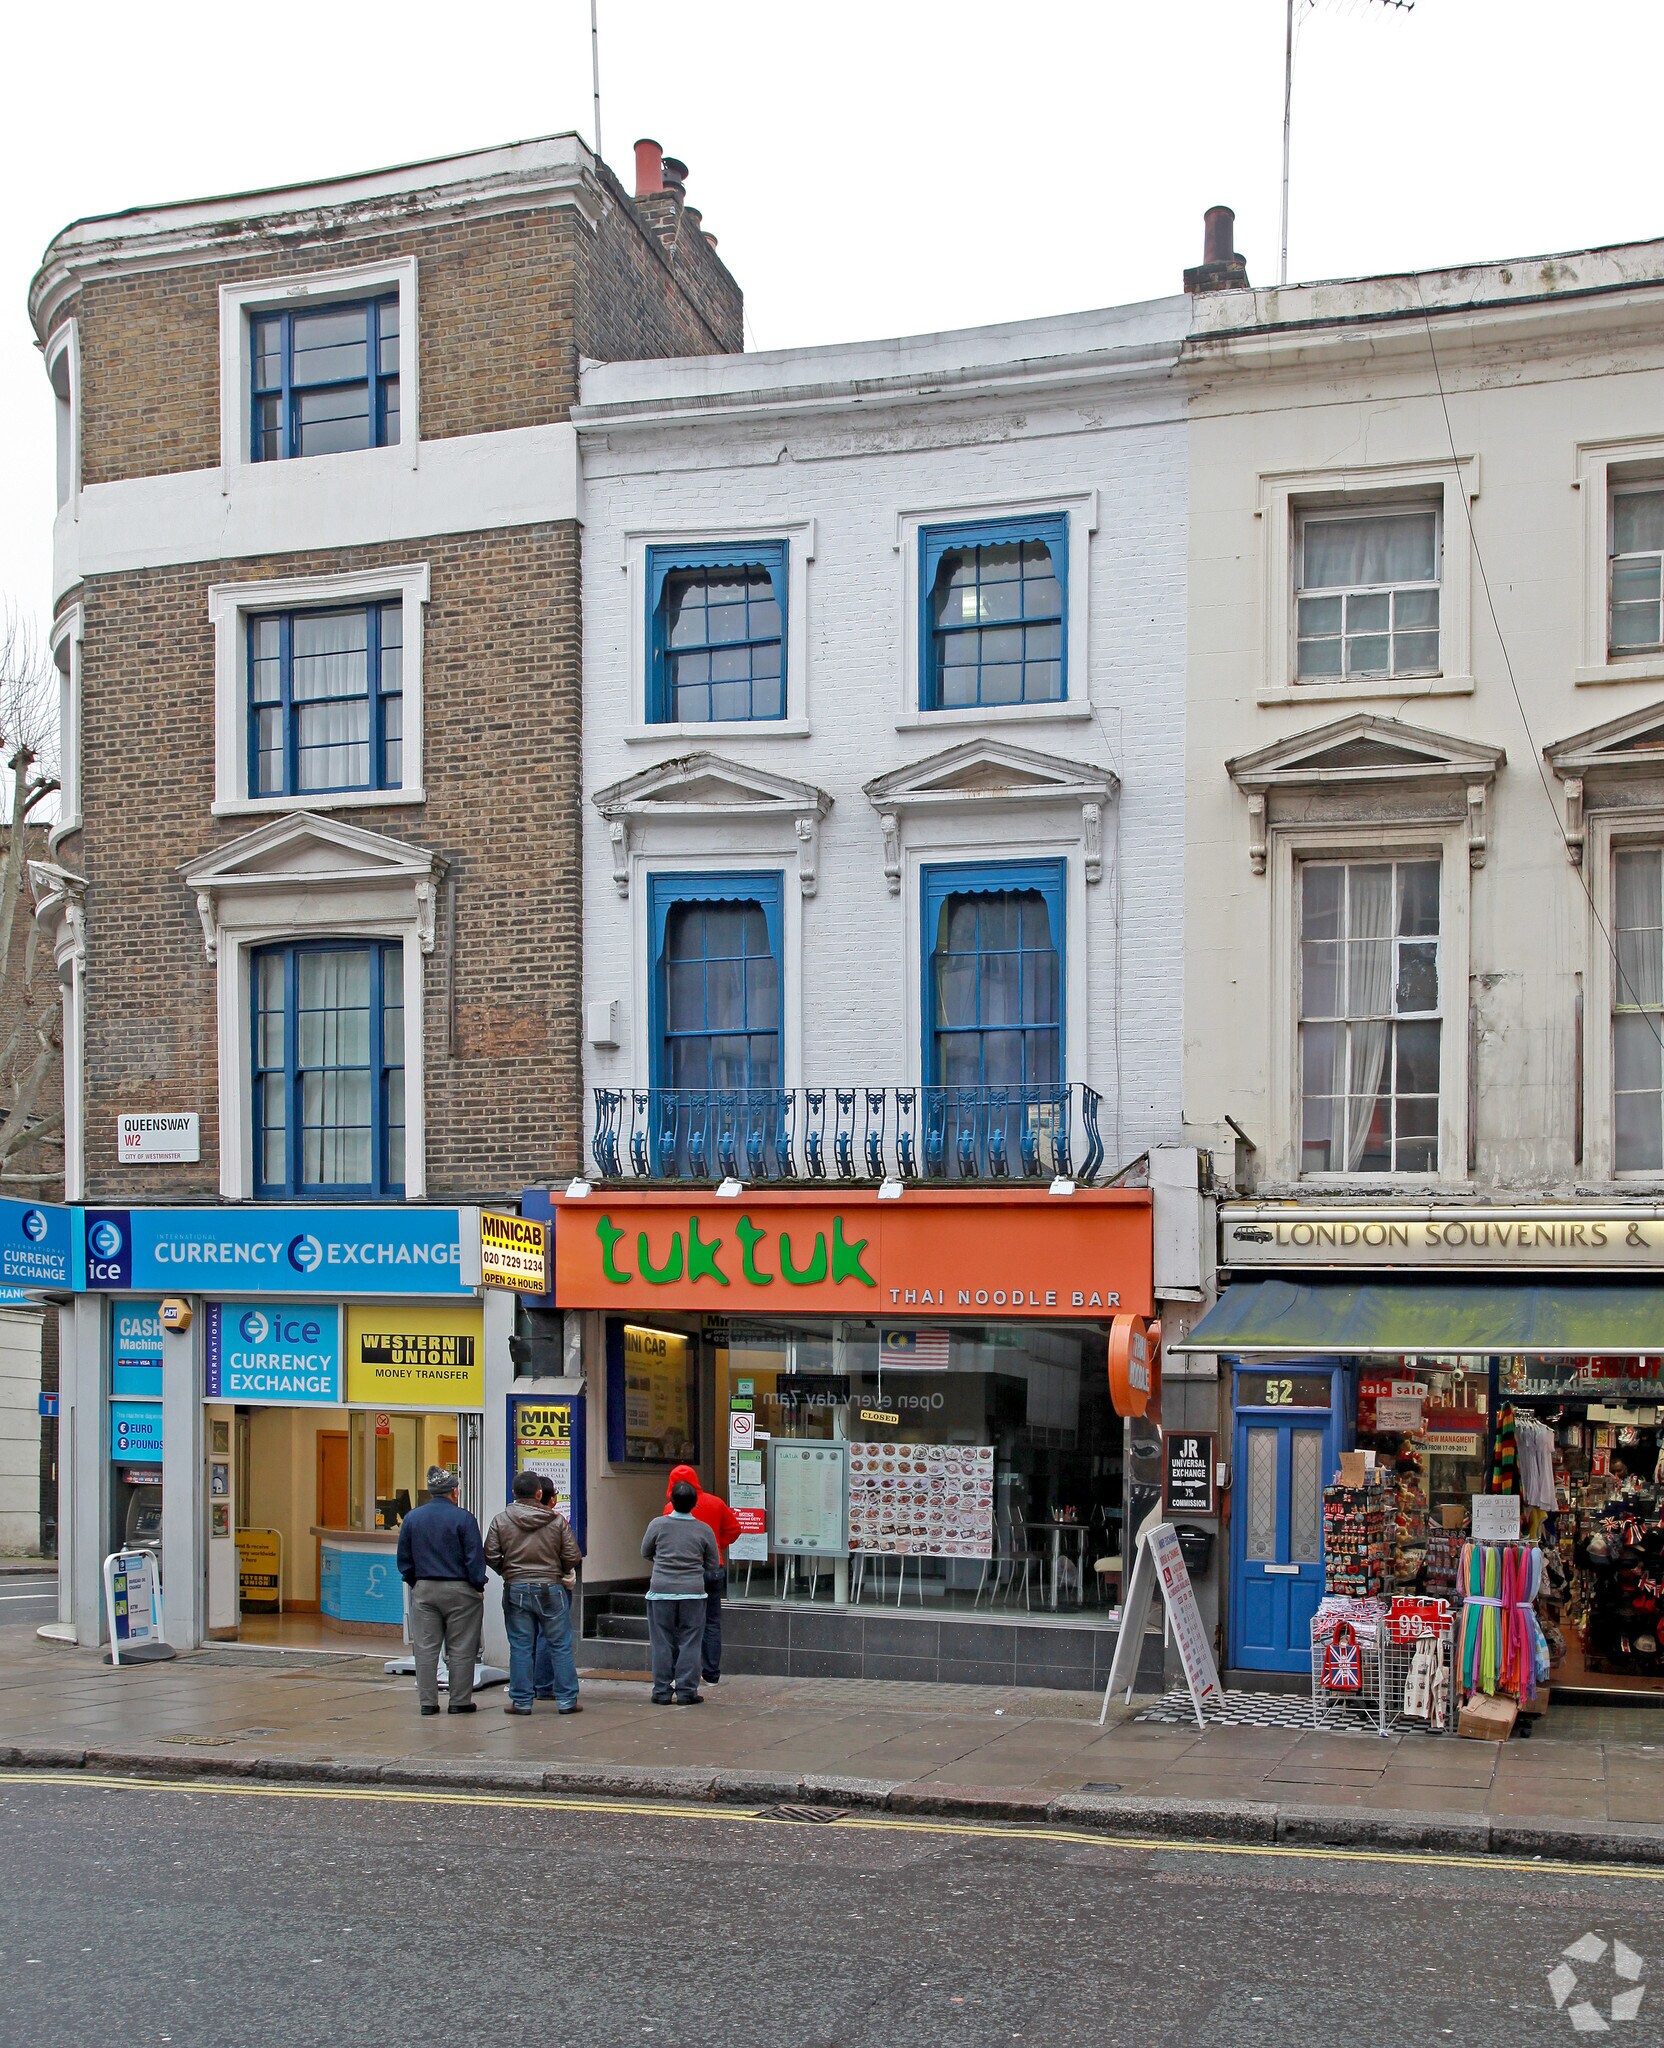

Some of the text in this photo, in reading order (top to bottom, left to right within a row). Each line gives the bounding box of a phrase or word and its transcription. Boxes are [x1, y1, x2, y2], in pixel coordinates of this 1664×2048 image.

[124, 1118, 190, 1132] QUEENSWAY
[124, 1134, 141, 1146] W2
[482, 1216, 542, 1246] MINICAB
[1276, 1222, 1652, 1248] LONDON SOUVENIRS &
[4, 1250, 64, 1267] CURRENCY
[154, 1242, 460, 1264] CURRENCY EXCHANGE
[88, 1258, 121, 1280] ice
[484, 1252, 543, 1272] 020 7229 1234
[4, 1264, 66, 1280] EXCHANGE
[484, 1272, 544, 1290] OPEN 24 HOURS
[889, 1289, 1121, 1307] THAI NOODLE BAR
[164, 1309, 178, 1318] ADT
[120, 1318, 163, 1336] CASH
[274, 1314, 320, 1344] ice
[120, 1338, 163, 1350] Machine
[362, 1335, 455, 1350] WESTERN
[644, 1336, 666, 1358] CAB
[230, 1352, 332, 1371] CURRENCY
[392, 1350, 455, 1364] UNION
[376, 1369, 469, 1380] MONEY TRANSFER
[230, 1374, 332, 1392] EXCHANGE
[1360, 1384, 1388, 1394] sale
[1396, 1386, 1423, 1395] sale
[1518, 1379, 1580, 1392] BUREAU
[1266, 1380, 1292, 1404] 52
[862, 1412, 898, 1423] CLOSED
[130, 1424, 152, 1434] EURO
[130, 1440, 163, 1450] POUNDS
[1180, 1439, 1198, 1458] JR
[1172, 1458, 1206, 1468] UNIVERSAL
[1172, 1469, 1206, 1478] EXCHANGE
[1476, 1509, 1480, 1518] 1
